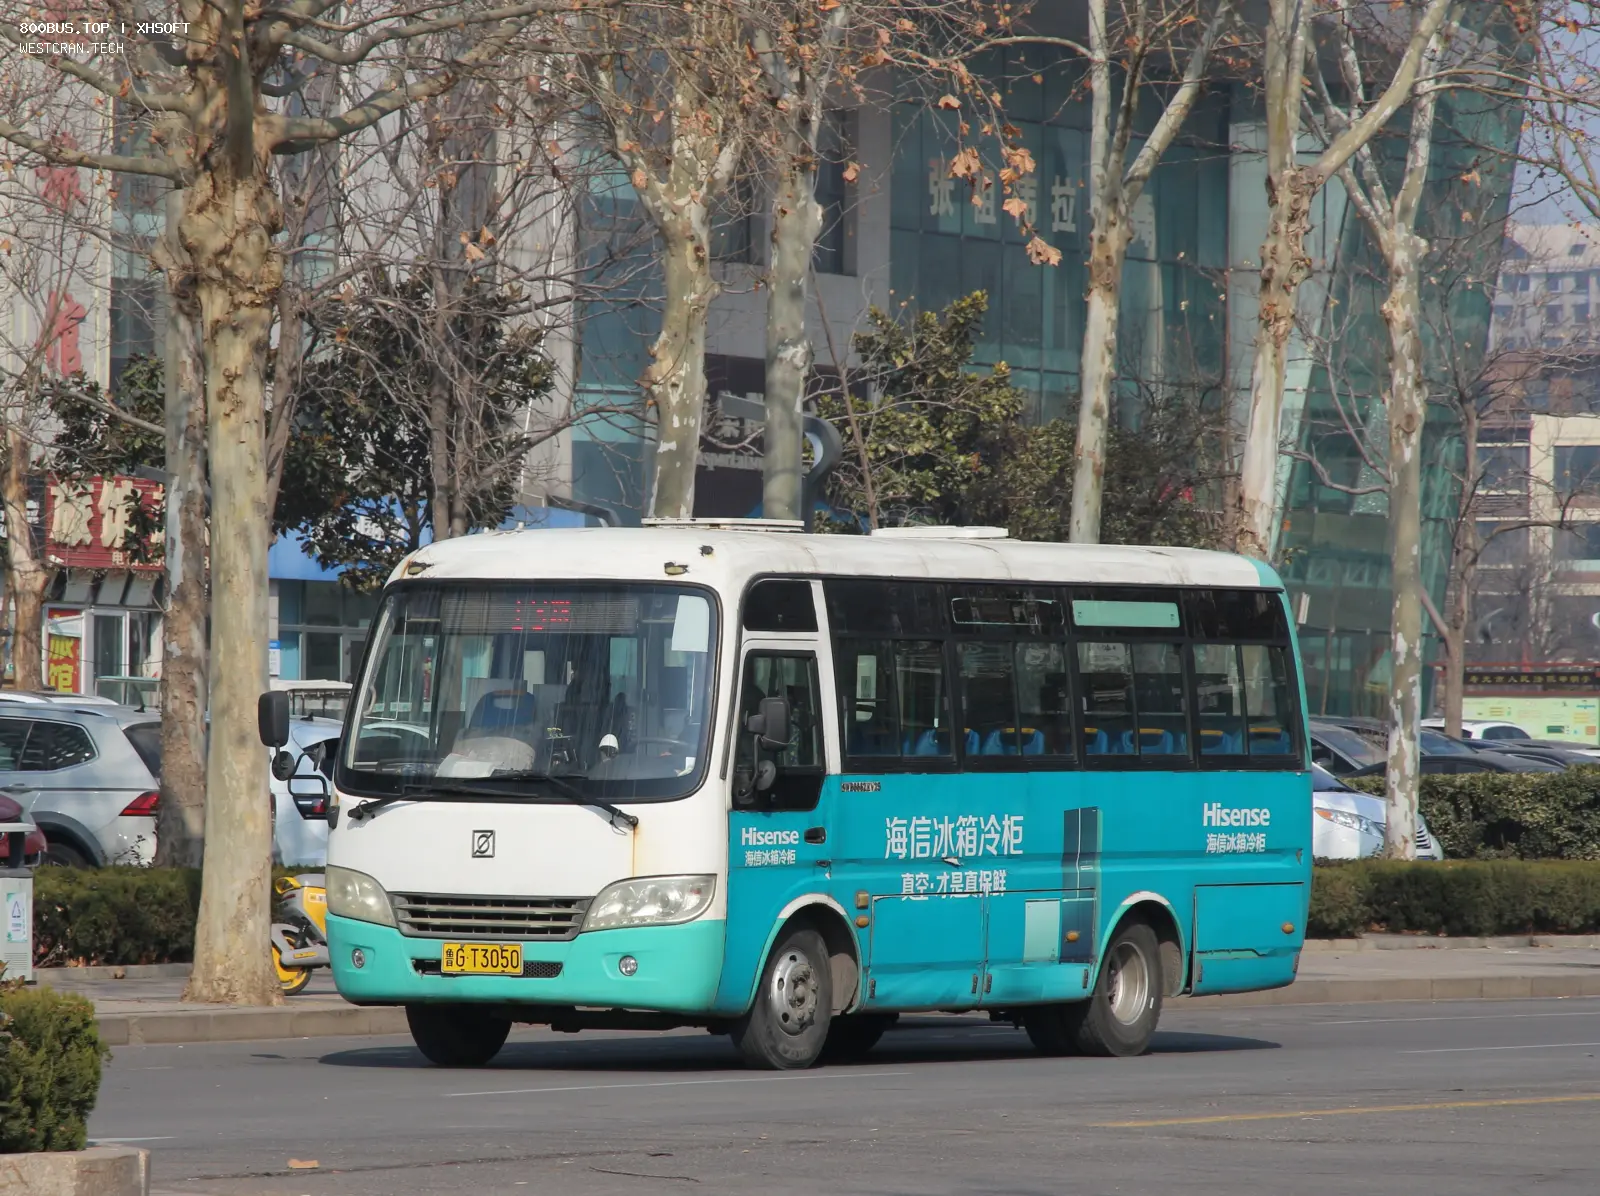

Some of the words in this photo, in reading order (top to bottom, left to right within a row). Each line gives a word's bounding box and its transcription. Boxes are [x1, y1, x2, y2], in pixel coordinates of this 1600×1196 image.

[1202, 802, 1271, 827] Hisense
[741, 826, 799, 846] Hisense
[885, 814, 1024, 859] 海信冰箱冷柜
[1206, 832, 1266, 853] 海信冰箱冷柜
[744, 849, 796, 866] 海信冰箱冷柜
